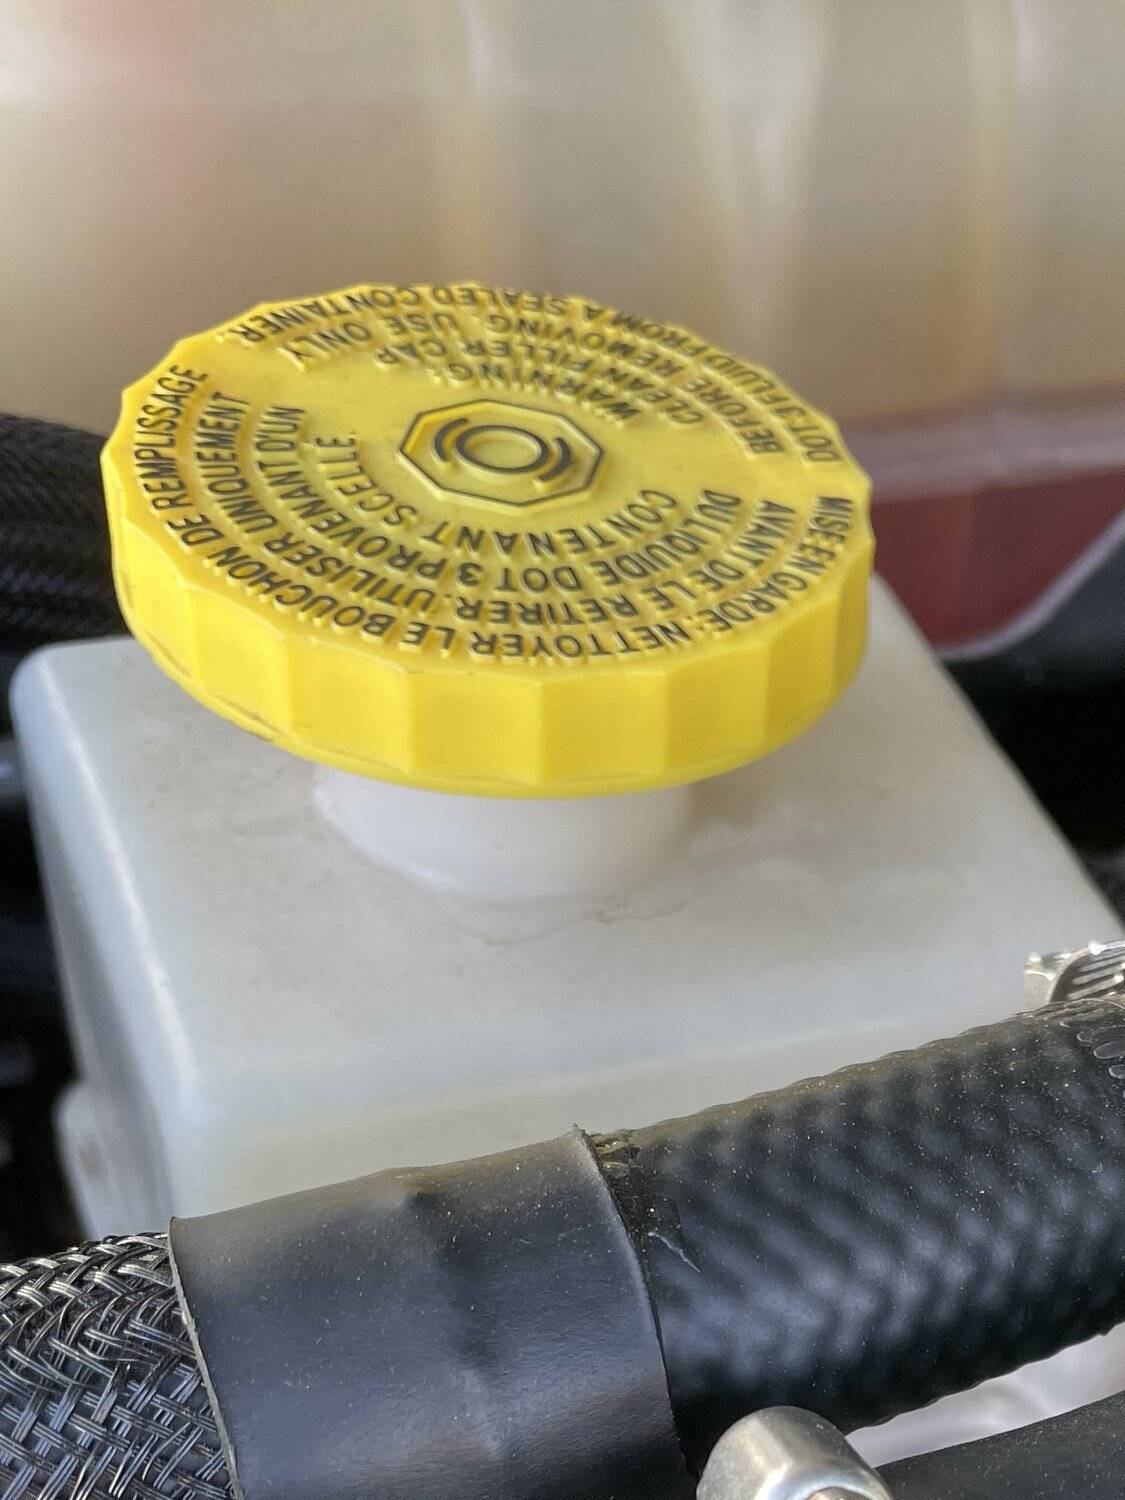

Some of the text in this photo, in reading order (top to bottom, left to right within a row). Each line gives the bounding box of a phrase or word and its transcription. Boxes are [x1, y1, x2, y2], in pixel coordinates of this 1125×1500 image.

[381, 313, 457, 335] USE
[432, 288, 565, 315] SEALED
[580, 306, 601, 322] A
[277, 323, 370, 367] ONLY
[611, 315, 707, 357] FROM
[375, 339, 704, 424] CLEAN FILLER CAP
[703, 356, 787, 404] FLUID
[681, 379, 784, 453] BEFORE
[195, 392, 277, 534] UNIQUEMENT
[785, 427, 839, 462] DOT
[134, 366, 853, 658] MISE EN GARDE: NETTOYER LE BOUCHON DE REMPLISSAGE
[254, 406, 740, 593] DU LIQUIDE DOT 3 PROVENANT D'UN
[421, 491, 677, 557] CONTENANT
[724, 500, 795, 569] AVANT
[263, 533, 435, 613] UTILISER
[641, 581, 694, 612] LE
[688, 559, 744, 593] DE
